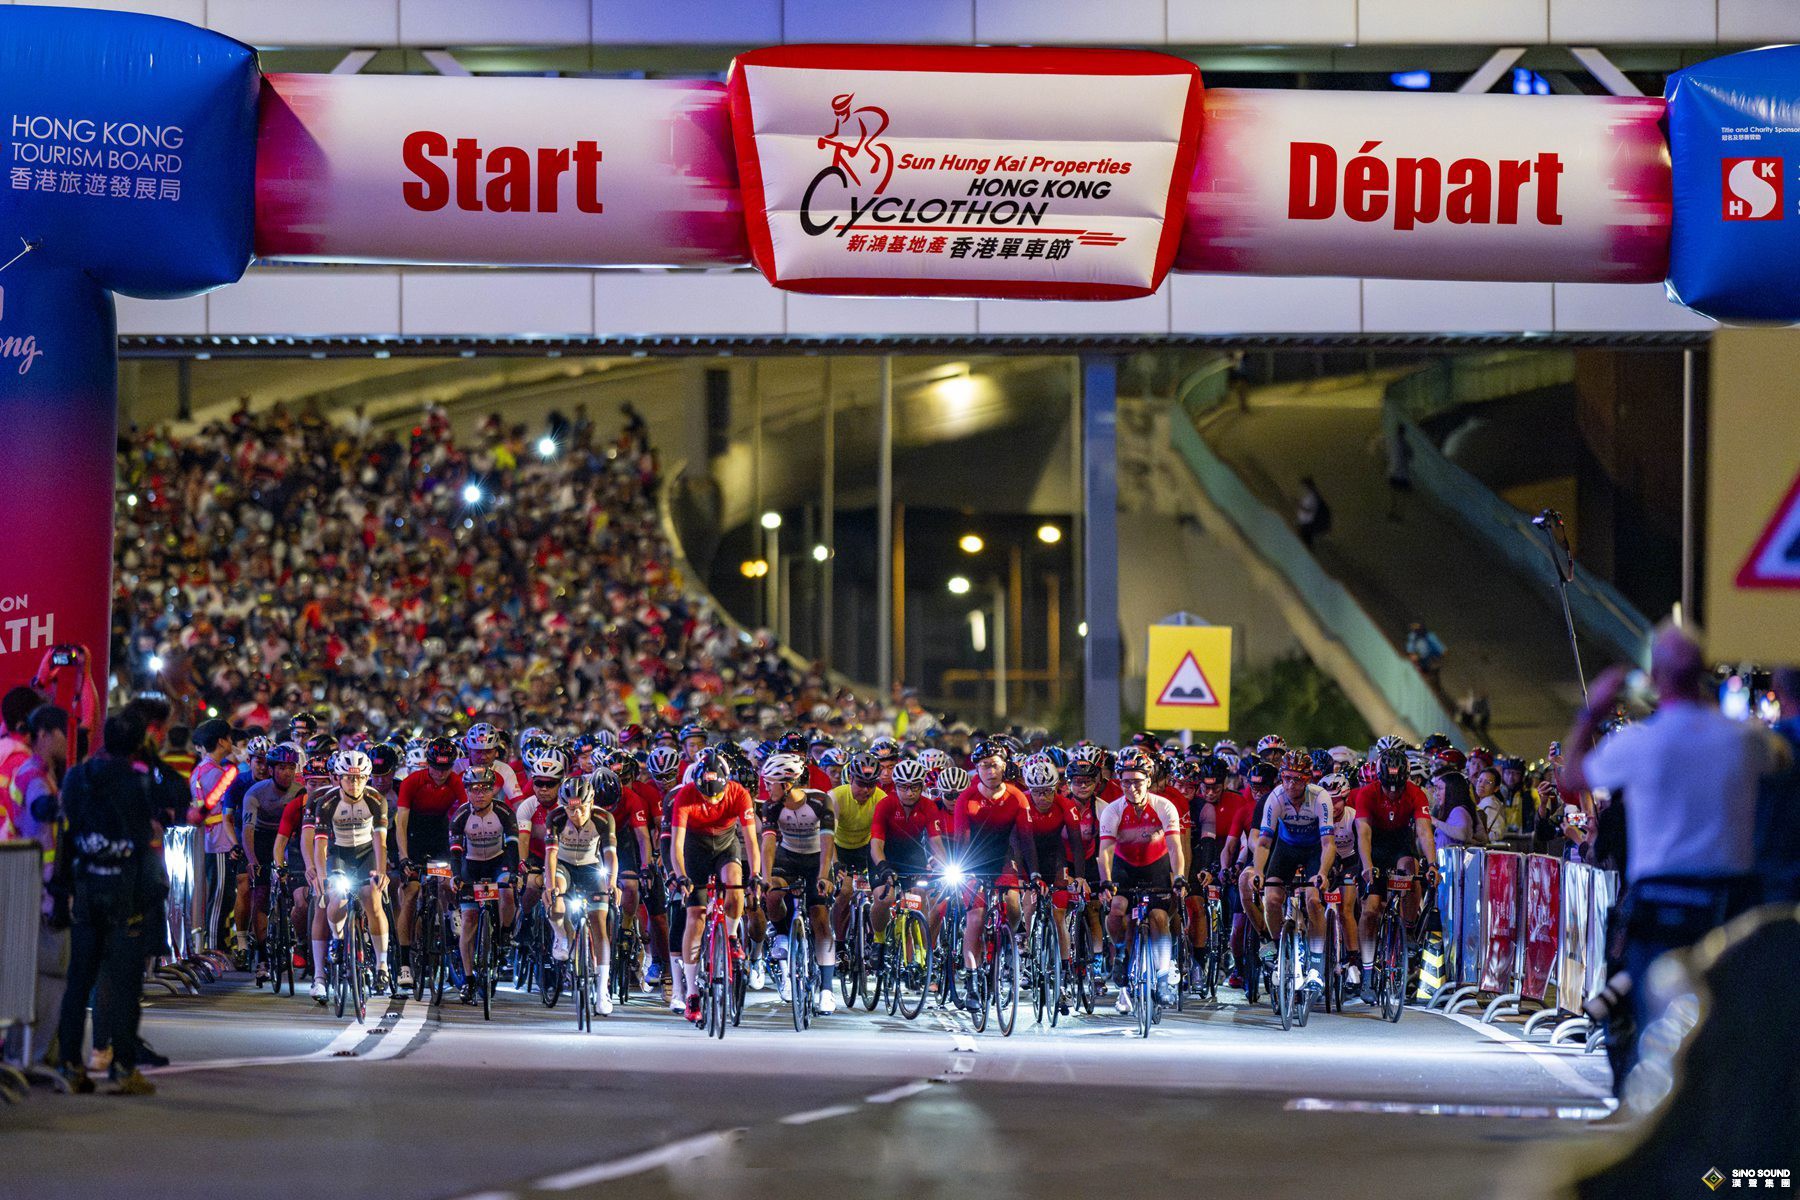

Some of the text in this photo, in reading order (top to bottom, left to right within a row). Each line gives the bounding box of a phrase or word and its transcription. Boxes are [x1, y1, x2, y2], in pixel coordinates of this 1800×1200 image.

[12, 114, 184, 149] HONG KONG
[1750, 126, 1773, 134] Charity
[11, 142, 182, 173] TOURISM BOARD
[402, 130, 604, 214] Start
[897, 153, 1132, 176] Sun Hung Kai Properties
[9, 166, 181, 202] 香港旅遊發展局
[967, 178, 1111, 200] HONG KONG
[1288, 140, 1564, 231] Départ
[847, 233, 1074, 261] 新鴻基地產 香港單車節
